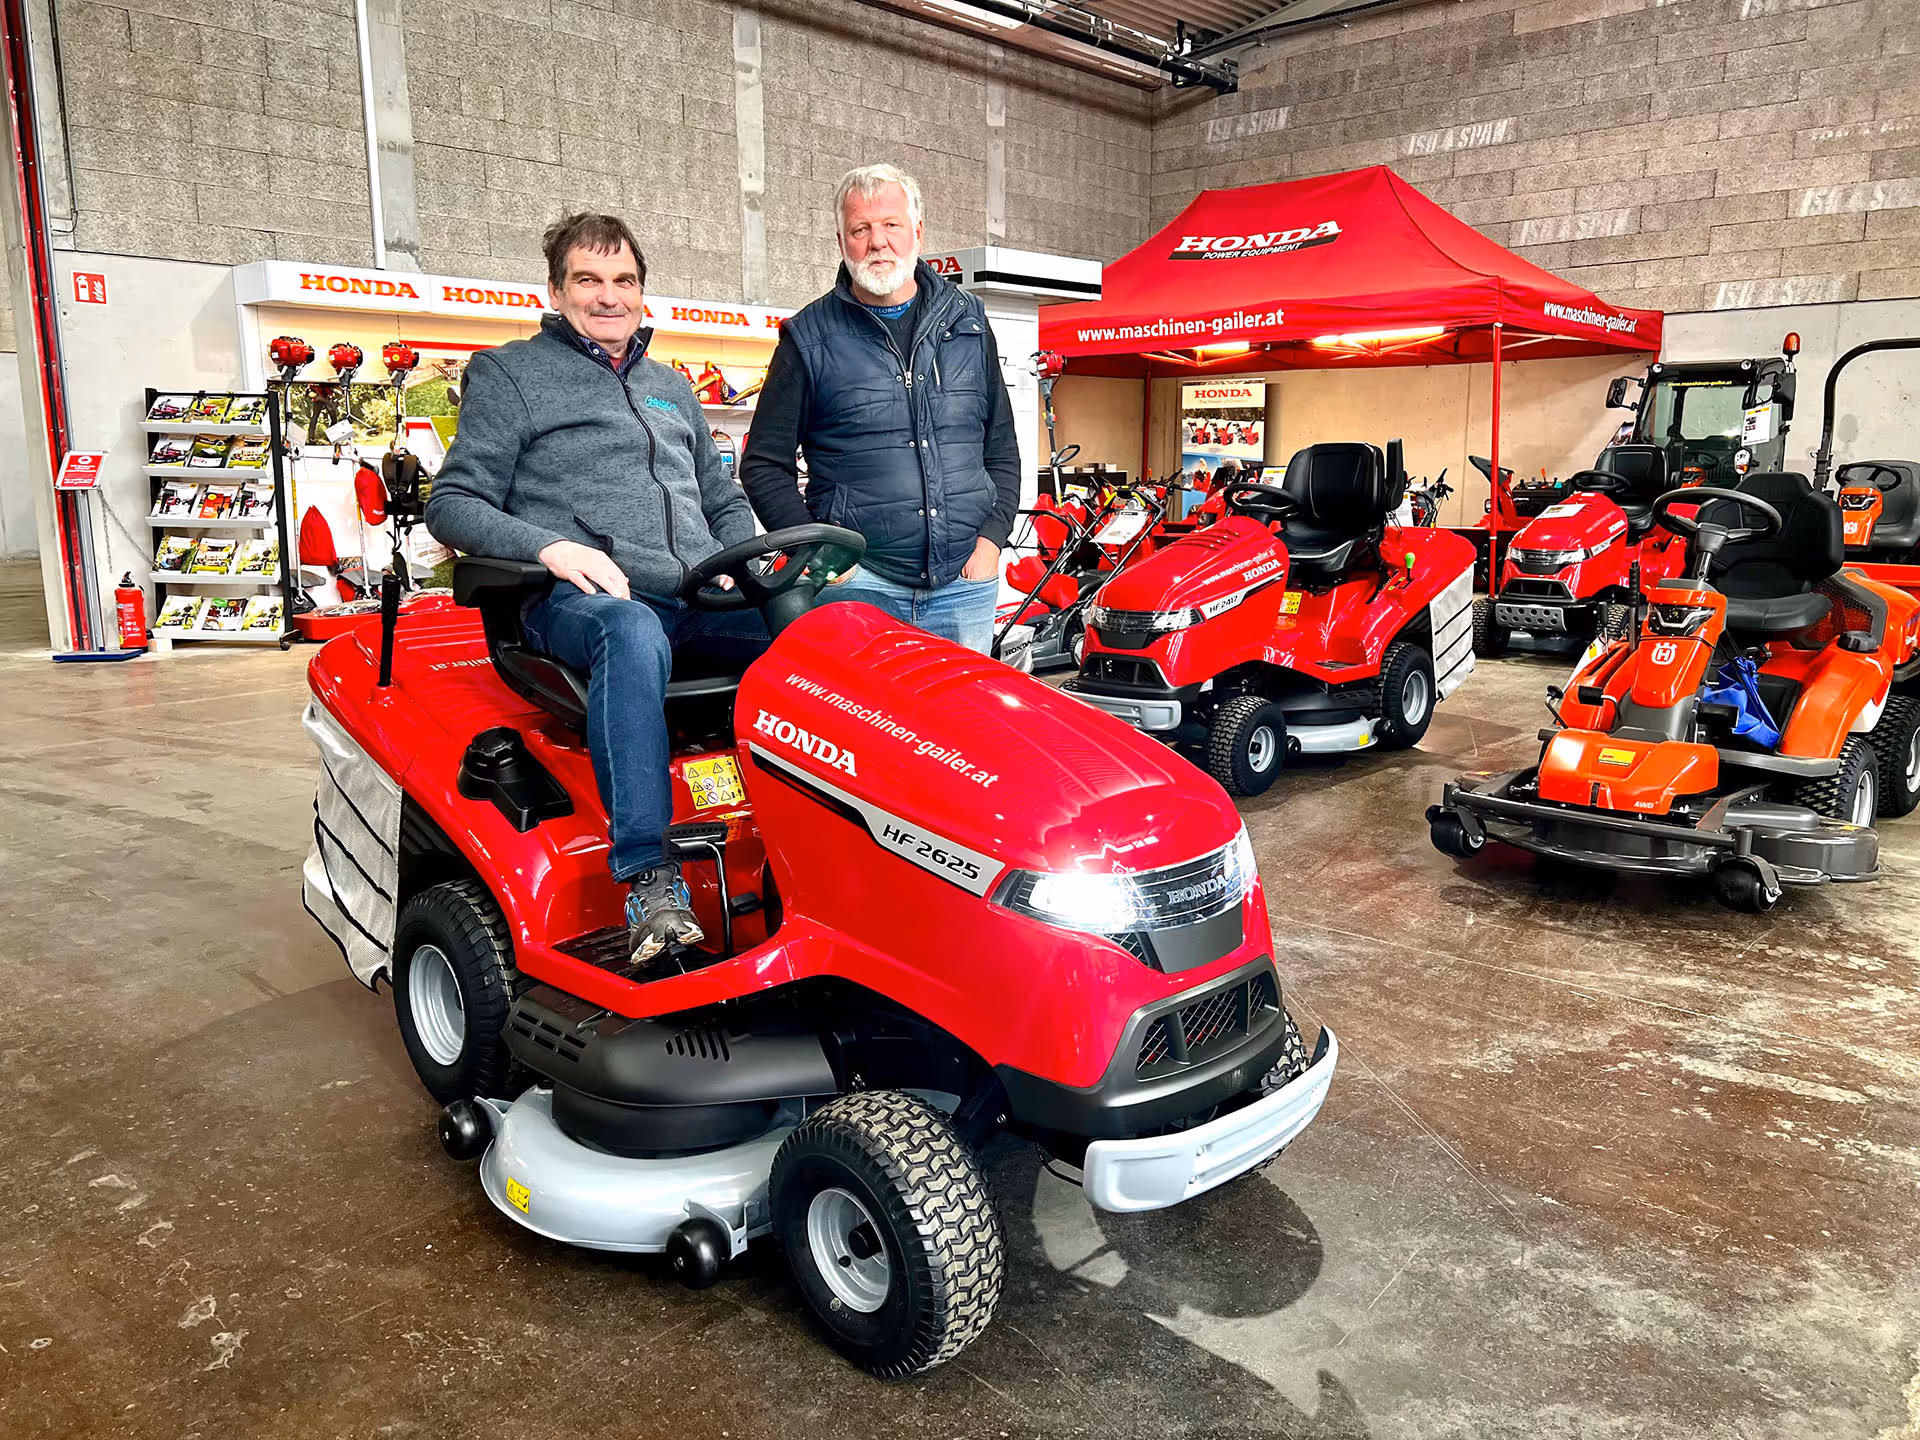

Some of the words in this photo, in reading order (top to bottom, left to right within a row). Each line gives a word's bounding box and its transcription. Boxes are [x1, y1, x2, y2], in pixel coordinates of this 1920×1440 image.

[1457, 119, 1508, 148] SPAN
[1173, 220, 1343, 252] HONDA
[1201, 250, 1243, 260] POWER
[1241, 242, 1303, 258] EQUIPMENT
[299, 273, 419, 298] HONDA
[442, 286, 544, 308] HONDA
[671, 306, 750, 326] HONDA
[1077, 308, 1285, 343] www.maschinen-gailer.at
[1543, 301, 1638, 333] www.maschinen-gailer.at
[1194, 389, 1252, 398] HONDA
[1202, 549, 1276, 585] www.maschinen-gailer.at
[1242, 559, 1281, 581] HONDA
[1209, 603, 1220, 613] HF
[1221, 595, 1238, 608] 2417
[1004, 640, 1033, 656] HONDA
[752, 709, 858, 777] HONDA
[785, 673, 999, 788] www.maschinen-gailer.at
[882, 823, 917, 846] HF
[915, 840, 981, 881] 2625
[1166, 874, 1226, 905] HONDA
